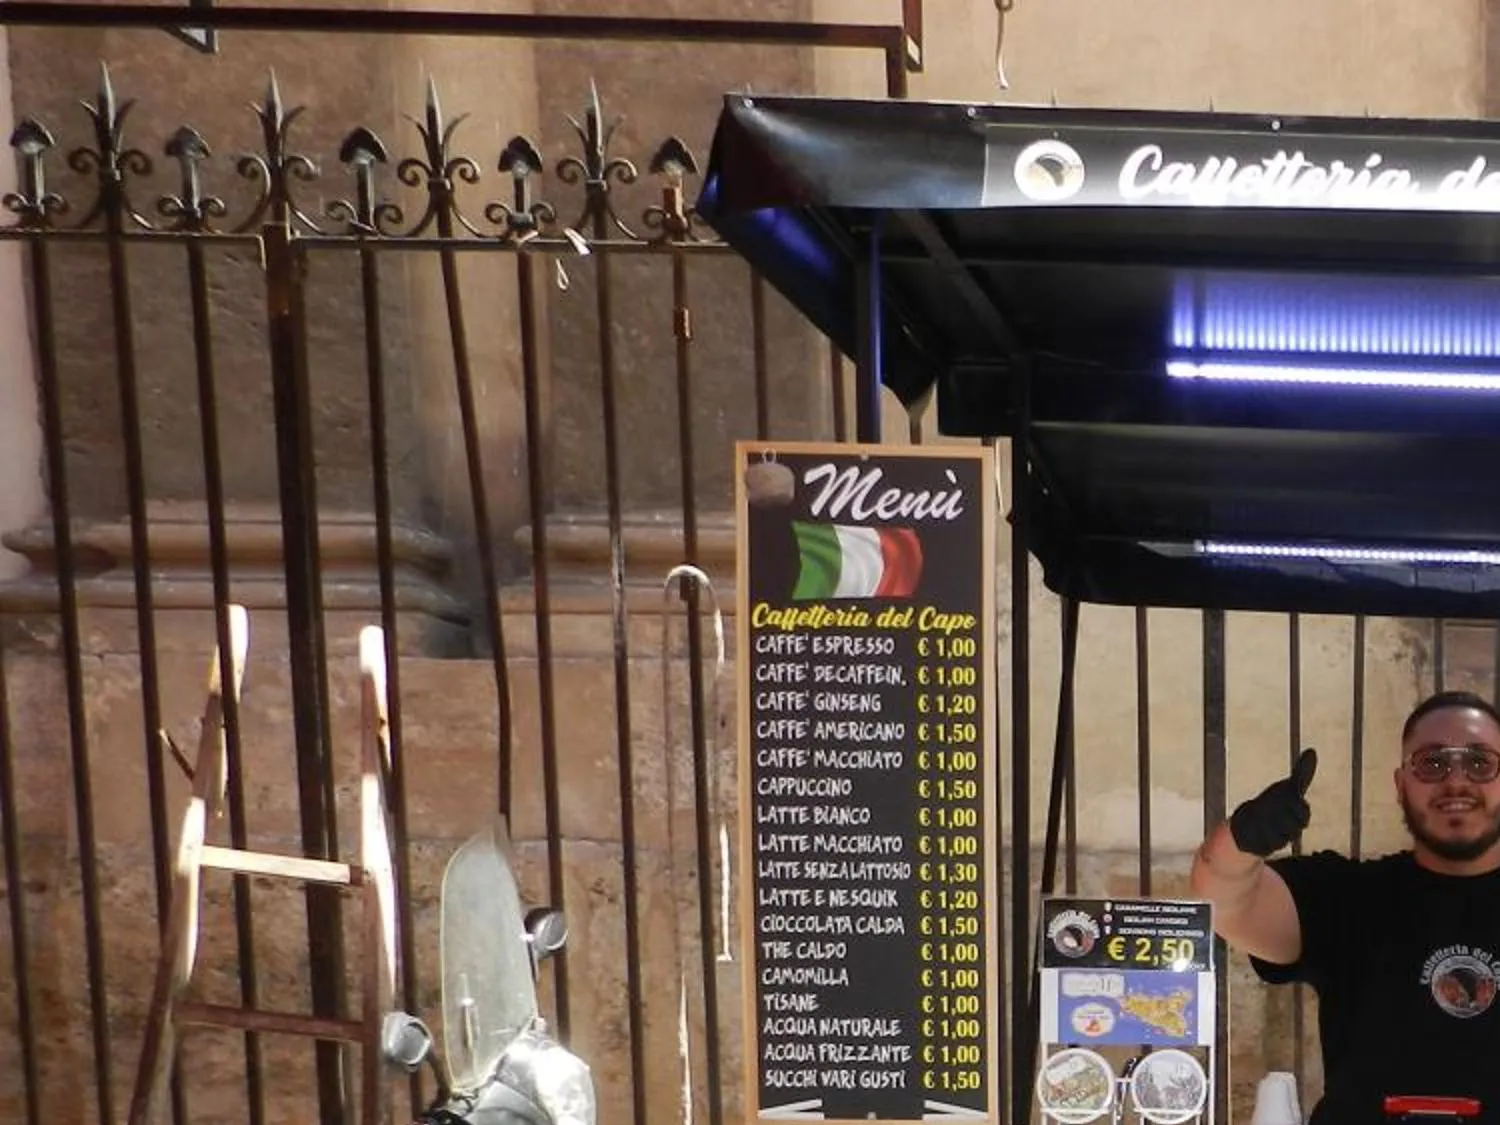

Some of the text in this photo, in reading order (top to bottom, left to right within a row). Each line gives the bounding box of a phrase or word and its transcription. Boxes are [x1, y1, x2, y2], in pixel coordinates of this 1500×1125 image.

[804, 463, 964, 520] Menù
[752, 603, 977, 634] Caffetteria del Capo
[756, 632, 975, 659] CAFFE' ESPRESSO € 1,00
[756, 662, 808, 683] CAFFE'
[918, 666, 930, 685] €
[936, 666, 975, 687] 1,00
[756, 692, 809, 712] CAFFE'
[918, 695, 930, 713] €
[936, 695, 976, 715] 1,20
[757, 719, 810, 739] CAFFE'
[918, 723, 930, 742] €
[936, 723, 976, 744] 1,50
[757, 748, 811, 768] CAFFE'
[918, 751, 930, 769] €
[936, 751, 976, 772] 1,00
[919, 779, 930, 798] €
[937, 779, 976, 800] 1,50
[757, 805, 810, 824] LATTE
[919, 808, 930, 826] €
[937, 808, 977, 829] 1,00
[758, 834, 810, 852] LATTE
[919, 836, 931, 854] €
[937, 836, 977, 857] 1,00
[759, 860, 801, 879] LATTE
[804, 861, 848, 880] SENZA
[920, 863, 932, 882] €
[938, 863, 977, 885] 1,30
[759, 888, 810, 906] LATTE
[815, 889, 824, 906] E
[920, 890, 932, 909] €
[938, 890, 978, 911] 1,20
[855, 916, 905, 935] CALDA
[920, 916, 932, 935] €
[938, 917, 978, 938] 1,50
[762, 940, 978, 963] THE CALDO € 1,00
[1107, 937, 1195, 966] € 2,50
[921, 969, 933, 987] €
[939, 969, 979, 990] 1,00
[922, 995, 934, 1013] €
[940, 995, 979, 1016] 1,00
[763, 1017, 980, 1040] ACQUA NATURALE € 1,00
[764, 1043, 816, 1062] ACQUA
[923, 1045, 935, 1064] €
[941, 1045, 980, 1066] 1,00
[923, 1071, 936, 1089] €
[942, 1071, 981, 1091] 1,50
